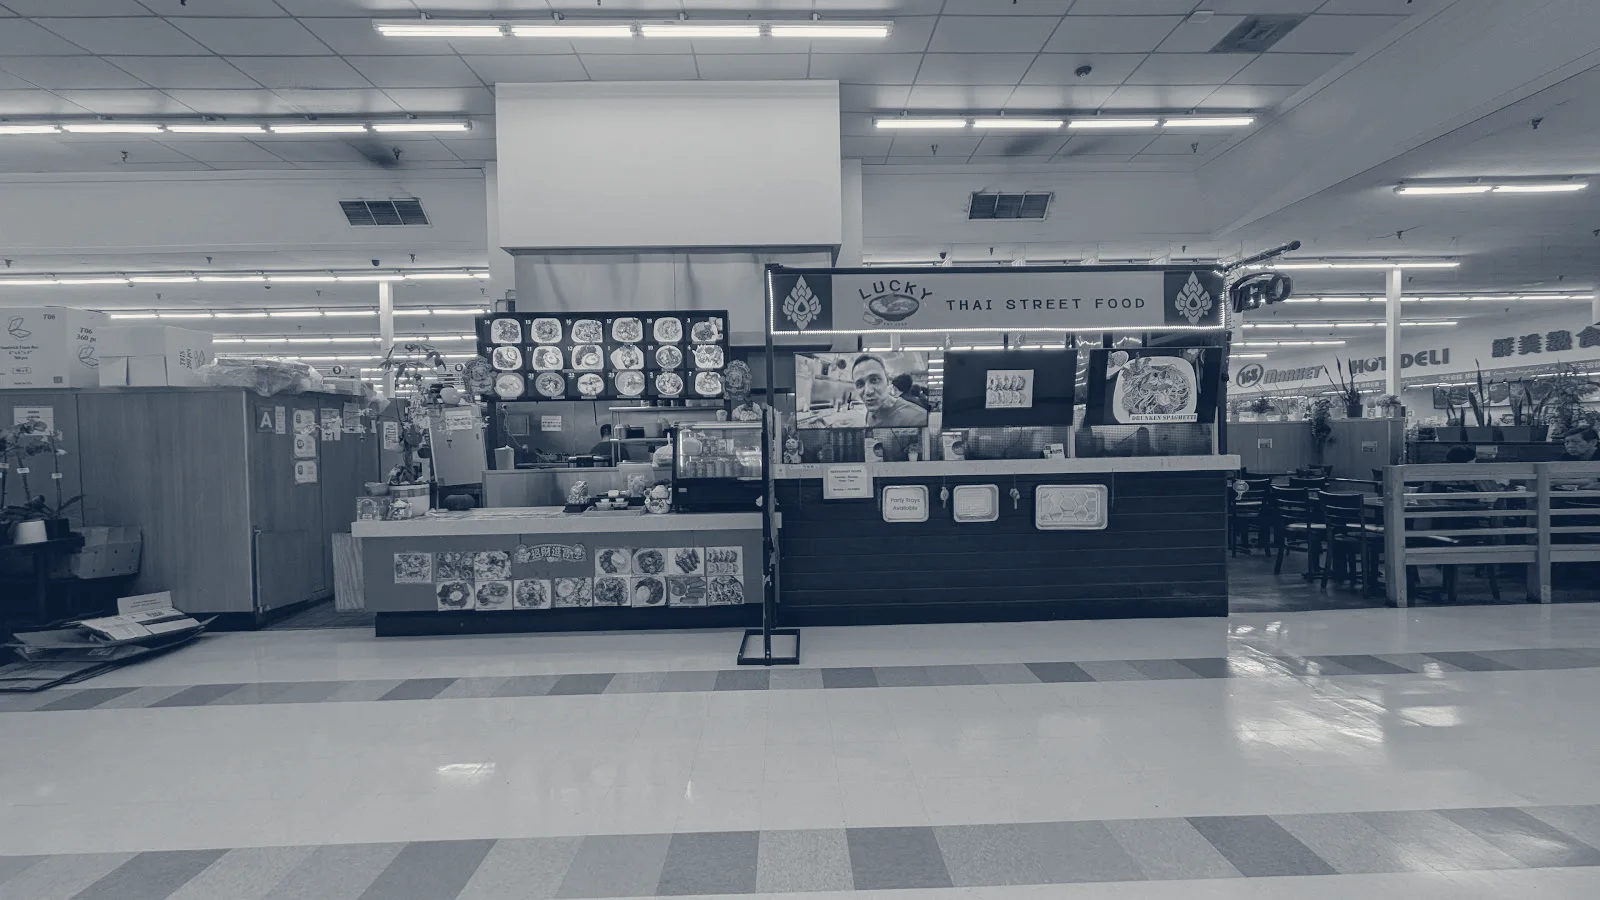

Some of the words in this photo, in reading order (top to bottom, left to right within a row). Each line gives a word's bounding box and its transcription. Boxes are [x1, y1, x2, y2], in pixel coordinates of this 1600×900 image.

[858, 279, 933, 300] LUCKY
[946, 299, 992, 311] THAI
[1006, 298, 1081, 310] STREET
[1095, 298, 1145, 309] FOOD
[80, 327, 93, 335] T06
[1351, 355, 1386, 374] HOT
[1400, 348, 1449, 368] DELI
[260, 411, 272, 428] A
